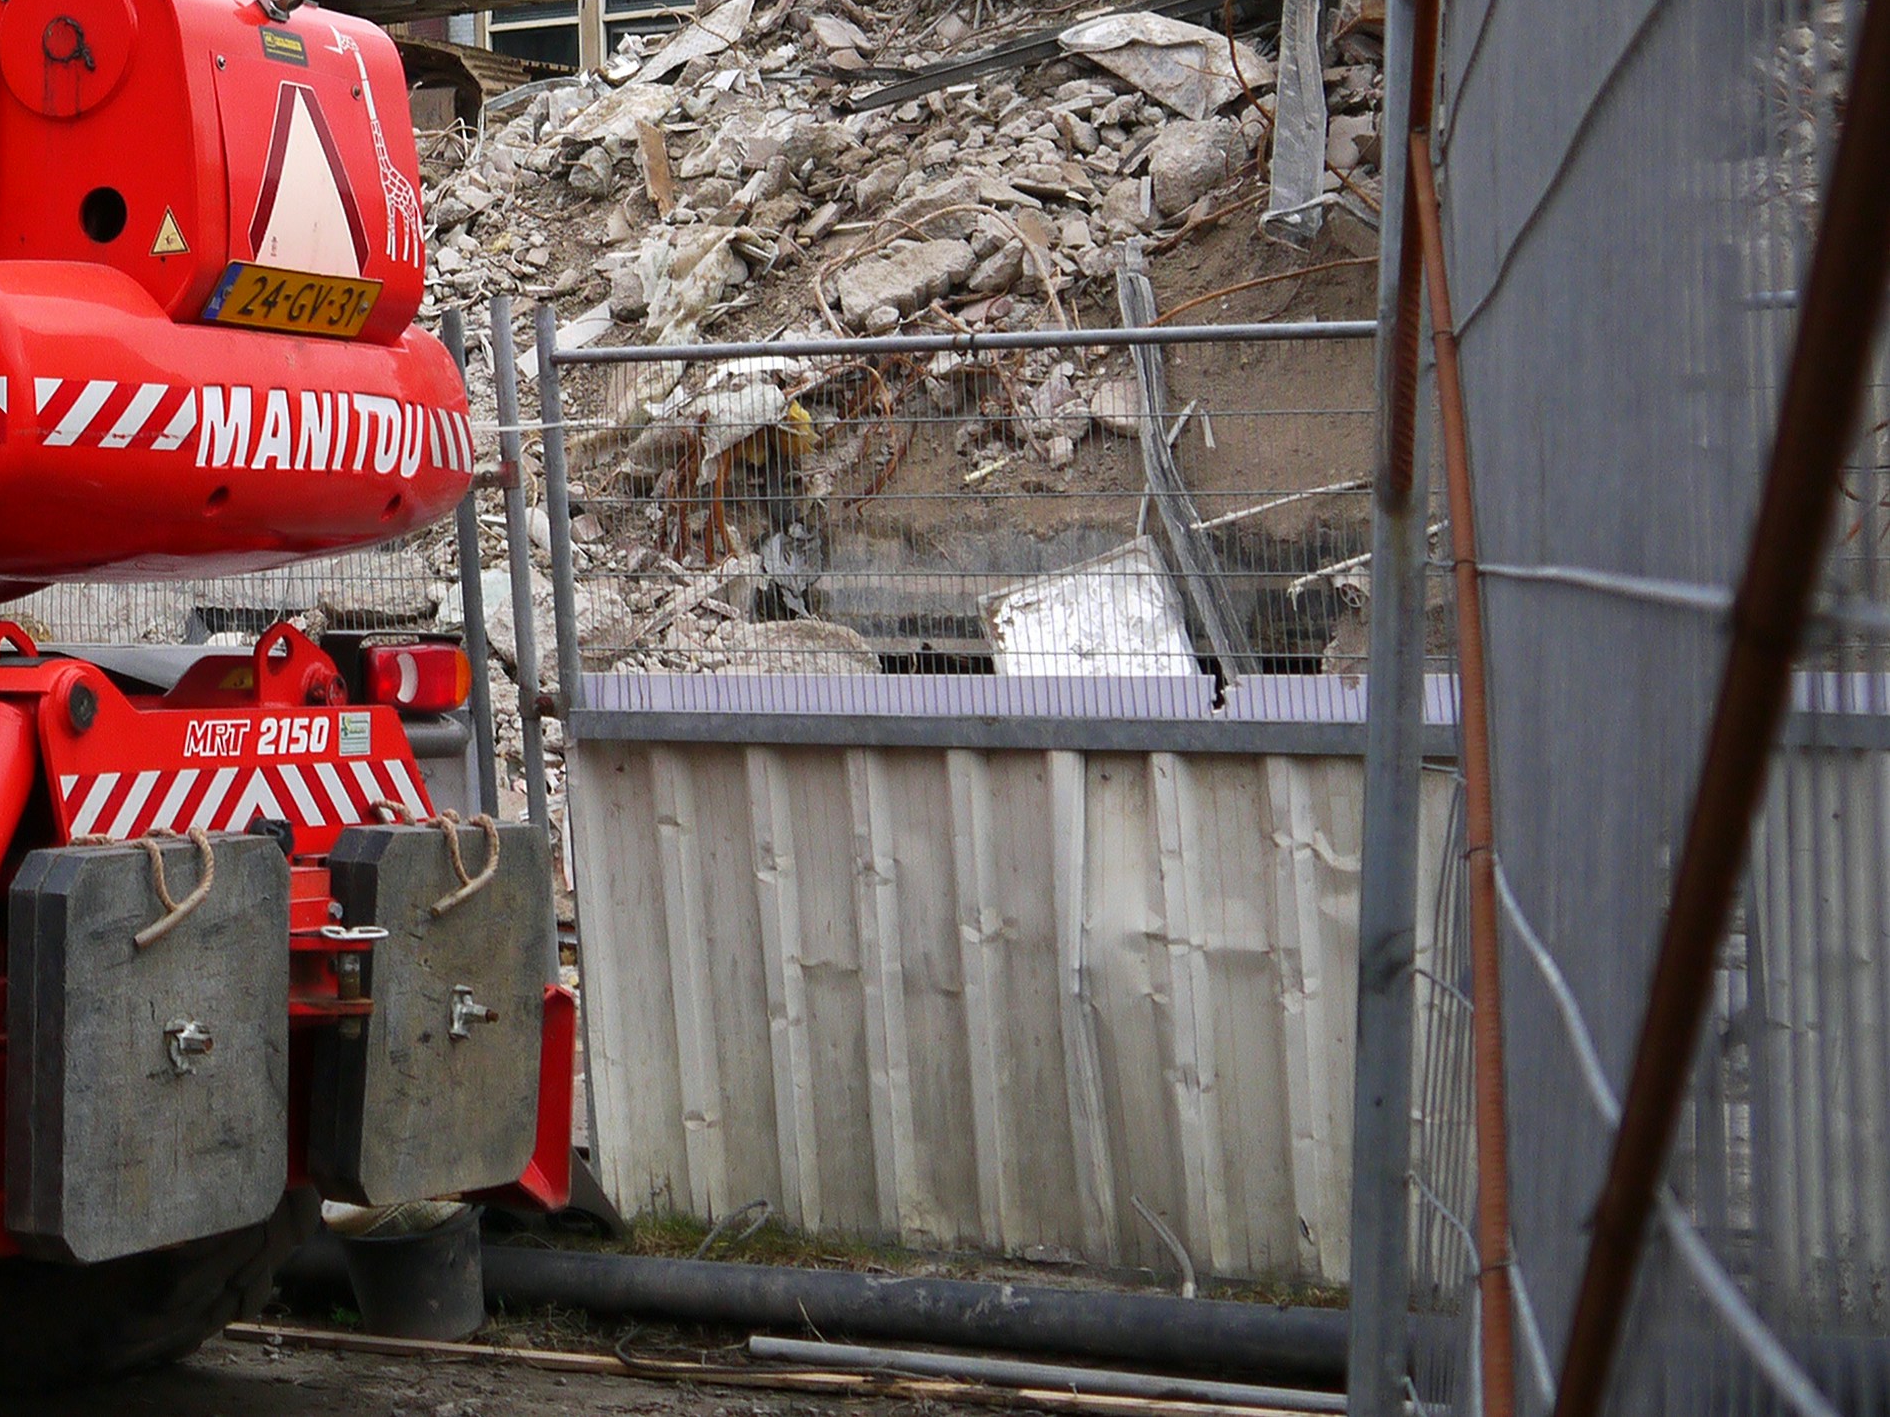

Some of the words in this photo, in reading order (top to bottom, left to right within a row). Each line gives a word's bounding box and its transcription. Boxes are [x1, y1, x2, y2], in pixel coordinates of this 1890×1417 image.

[237, 275, 366, 328] 24-GV-31
[195, 385, 425, 478] MANITOU
[183, 719, 251, 757] MRT
[257, 716, 330, 755] 2150
